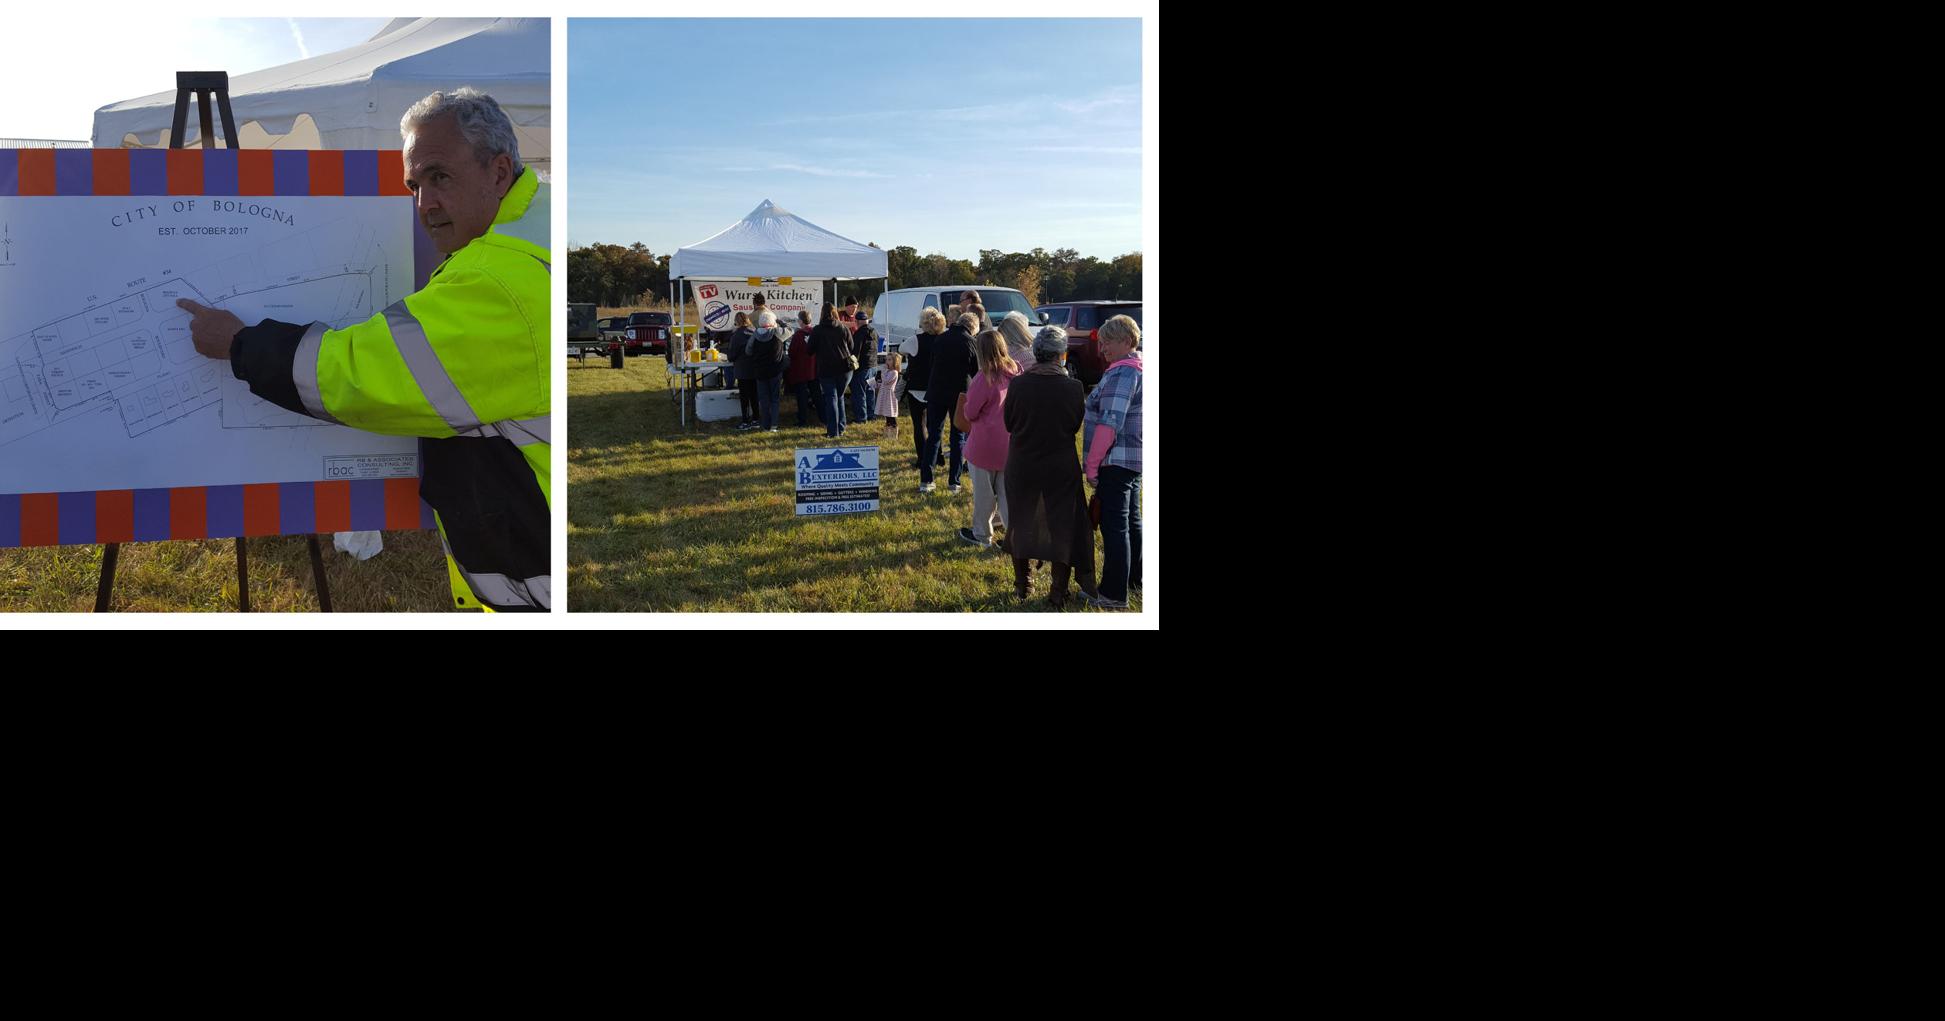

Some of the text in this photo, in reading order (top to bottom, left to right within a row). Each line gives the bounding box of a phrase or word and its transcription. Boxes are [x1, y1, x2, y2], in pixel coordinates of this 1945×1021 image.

[111, 200, 295, 227] CITY OF BOLOGNA
[183, 227, 226, 235] OCTOBER
[228, 227, 249, 235] 2017
[700, 287, 717, 298] TV
[767, 289, 813, 301] Kitchen
[798, 456, 811, 469] A
[328, 462, 354, 476] rbac
[799, 472, 811, 485] B
[806, 502, 871, 513] 815.786.3100
